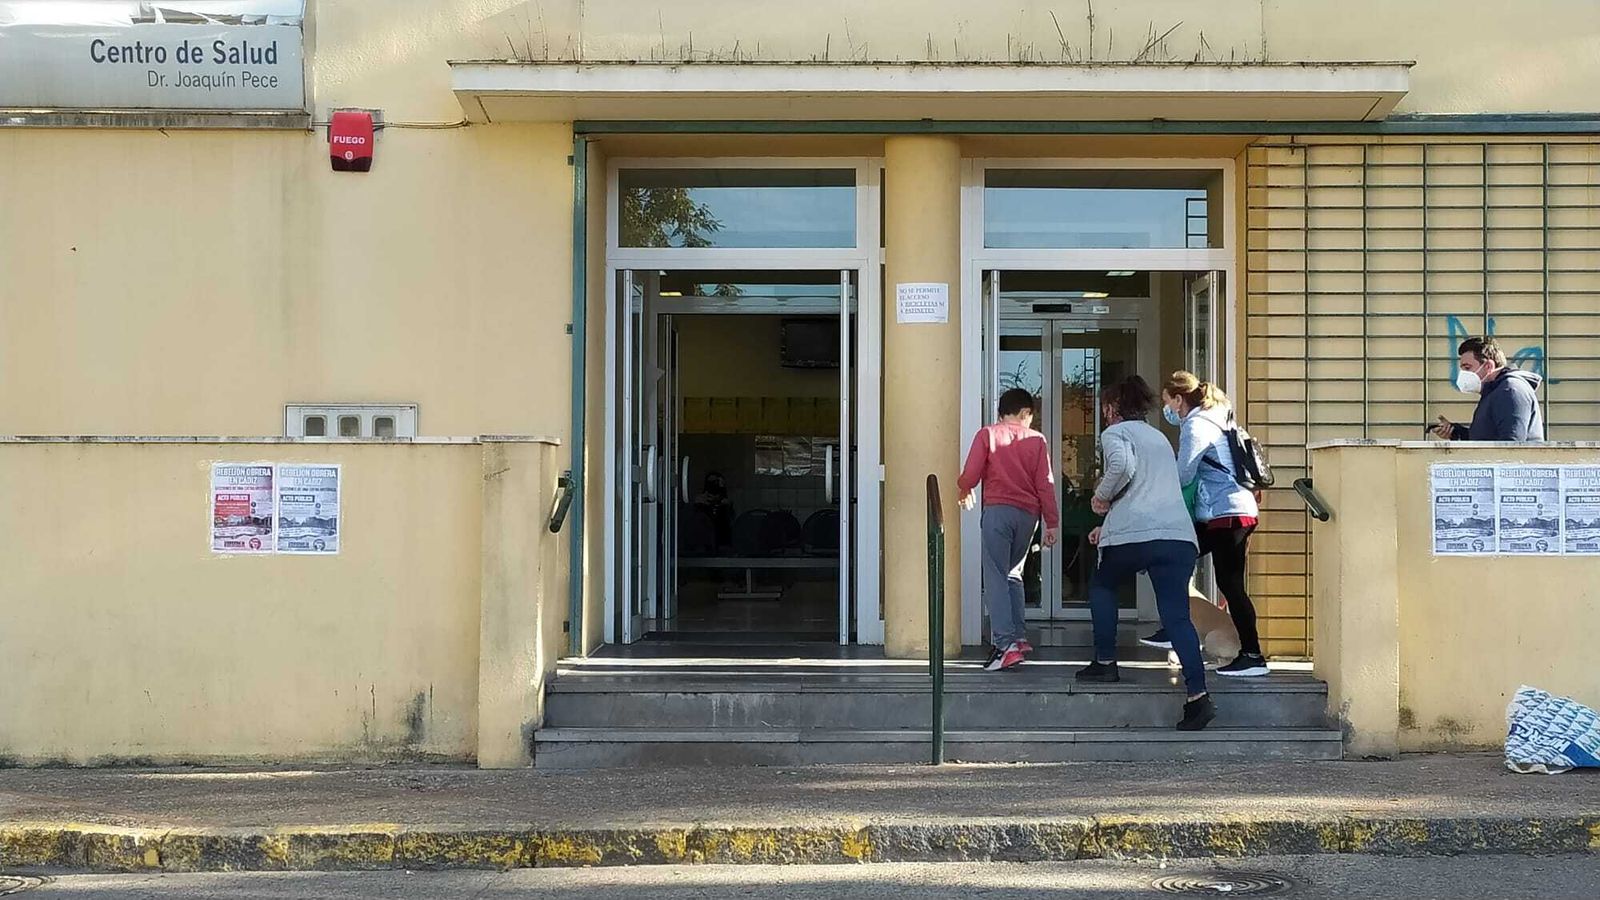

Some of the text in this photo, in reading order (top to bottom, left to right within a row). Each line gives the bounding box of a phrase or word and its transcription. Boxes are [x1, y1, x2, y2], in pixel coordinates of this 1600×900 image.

[90, 39, 278, 65] Centro de Salud
[147, 70, 278, 91] Dr. Joaquín Pece
[333, 136, 365, 144] FUEGO
[246, 468, 271, 476] OBRERA
[311, 469, 336, 478] OBRERA
[1466, 469, 1492, 478] OBRERA
[1531, 469, 1557, 478] OBRERA
[1451, 478, 1459, 486] EN
[1515, 478, 1523, 486] EN
